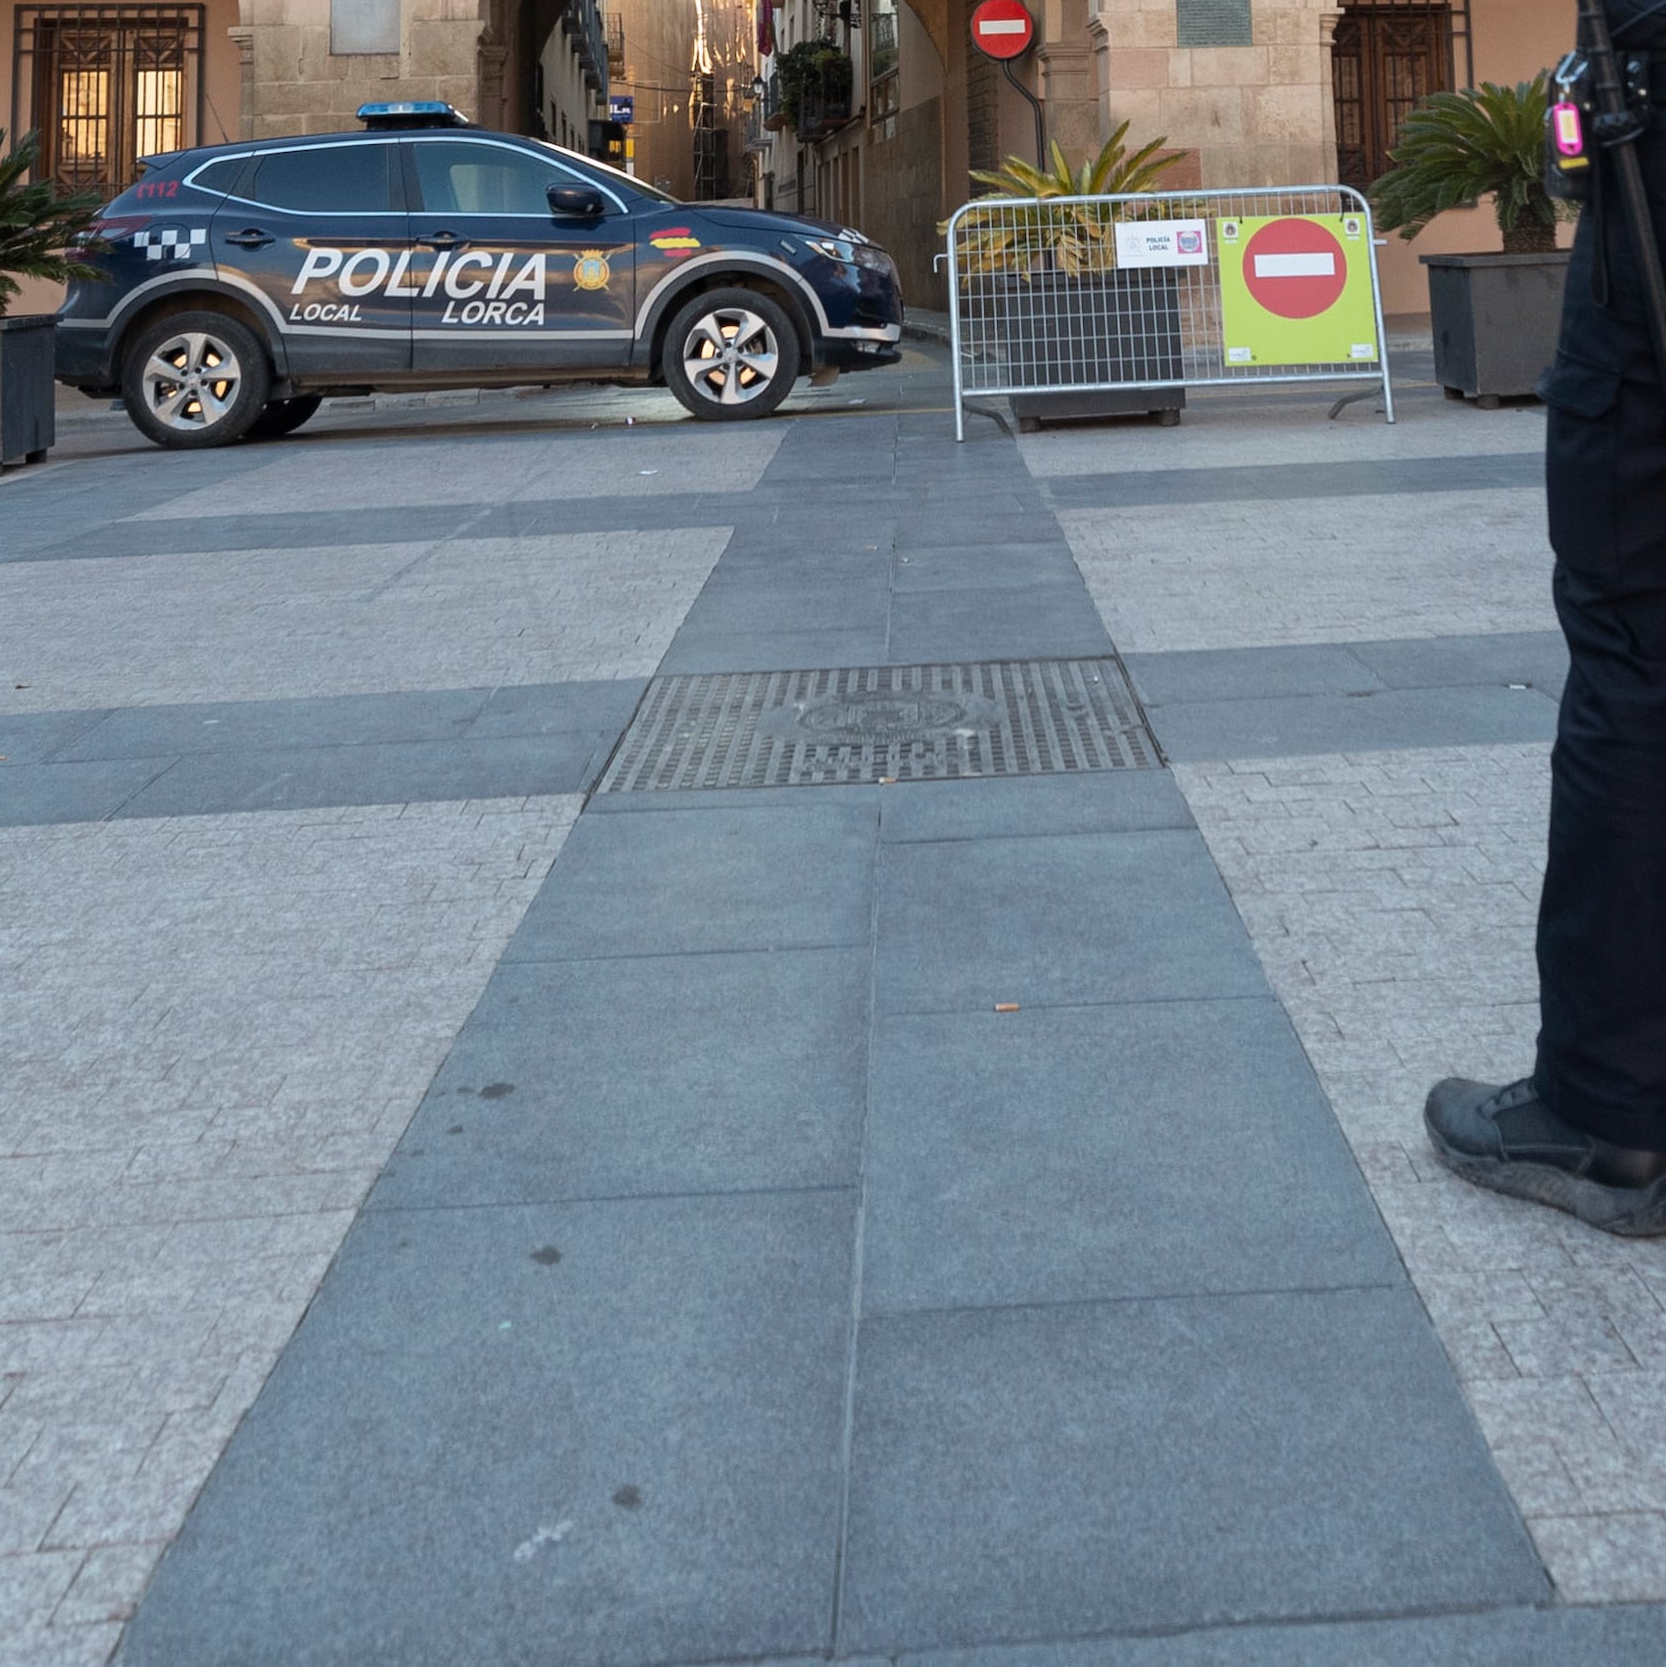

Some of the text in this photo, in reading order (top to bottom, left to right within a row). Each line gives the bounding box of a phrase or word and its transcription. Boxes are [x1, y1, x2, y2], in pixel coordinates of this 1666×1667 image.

[147, 180, 179, 198] 112
[1149, 244, 1169, 252] LOCAL
[291, 247, 546, 300] POLICIA
[289, 301, 545, 325] LOCAL LORCA
